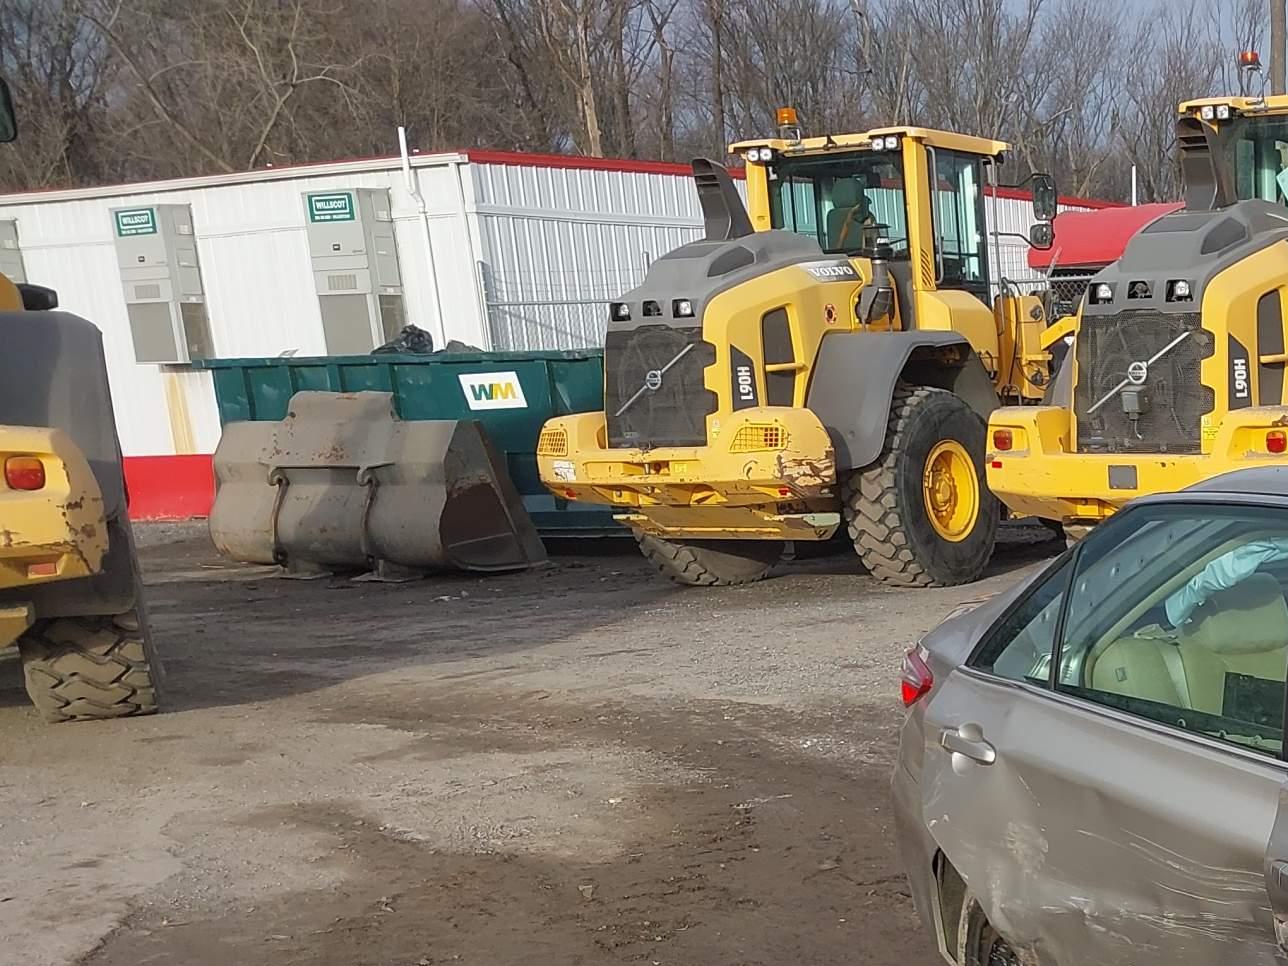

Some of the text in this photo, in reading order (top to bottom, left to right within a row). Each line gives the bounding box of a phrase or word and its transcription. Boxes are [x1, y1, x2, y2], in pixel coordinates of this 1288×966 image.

[315, 200, 346, 209] WILLSCOT
[807, 266, 854, 277] VOLVO
[736, 366, 754, 400] L90H
[1233, 358, 1248, 398] L90H
[469, 382, 517, 401] WM
